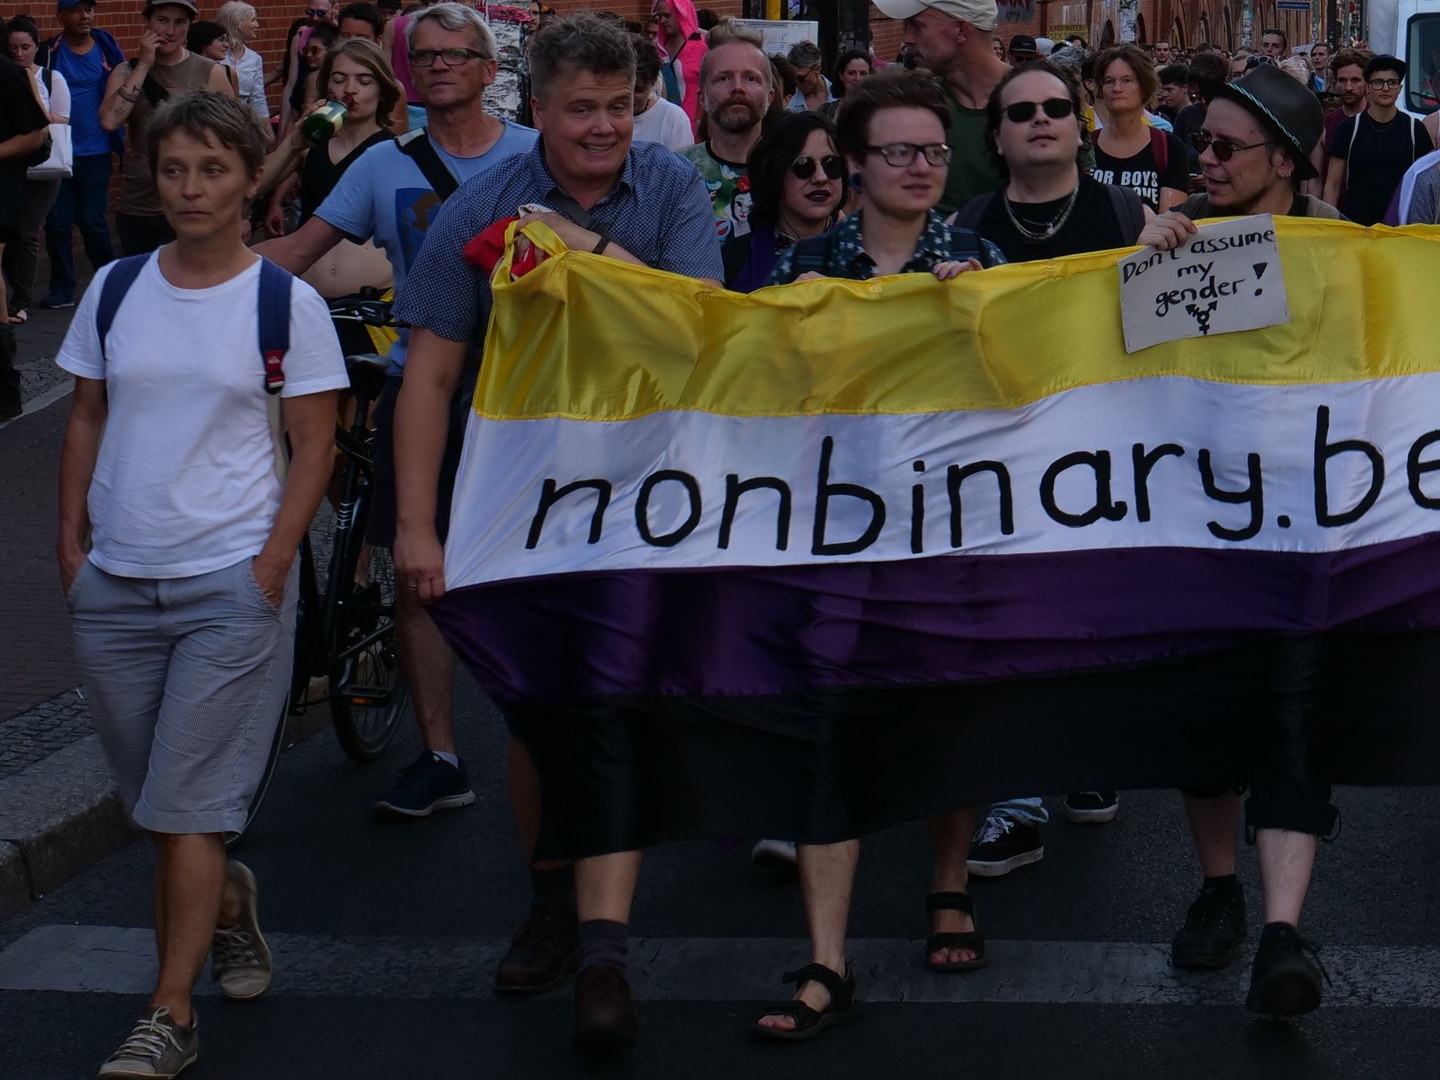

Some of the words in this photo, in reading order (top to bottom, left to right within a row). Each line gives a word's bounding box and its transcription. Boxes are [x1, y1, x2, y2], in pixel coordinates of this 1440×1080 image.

[1120, 170, 1159, 188] BOYS
[1132, 186, 1159, 205] OVE
[1123, 248, 1180, 285] Dont
[1190, 229, 1276, 255] assume
[1177, 261, 1215, 282] my
